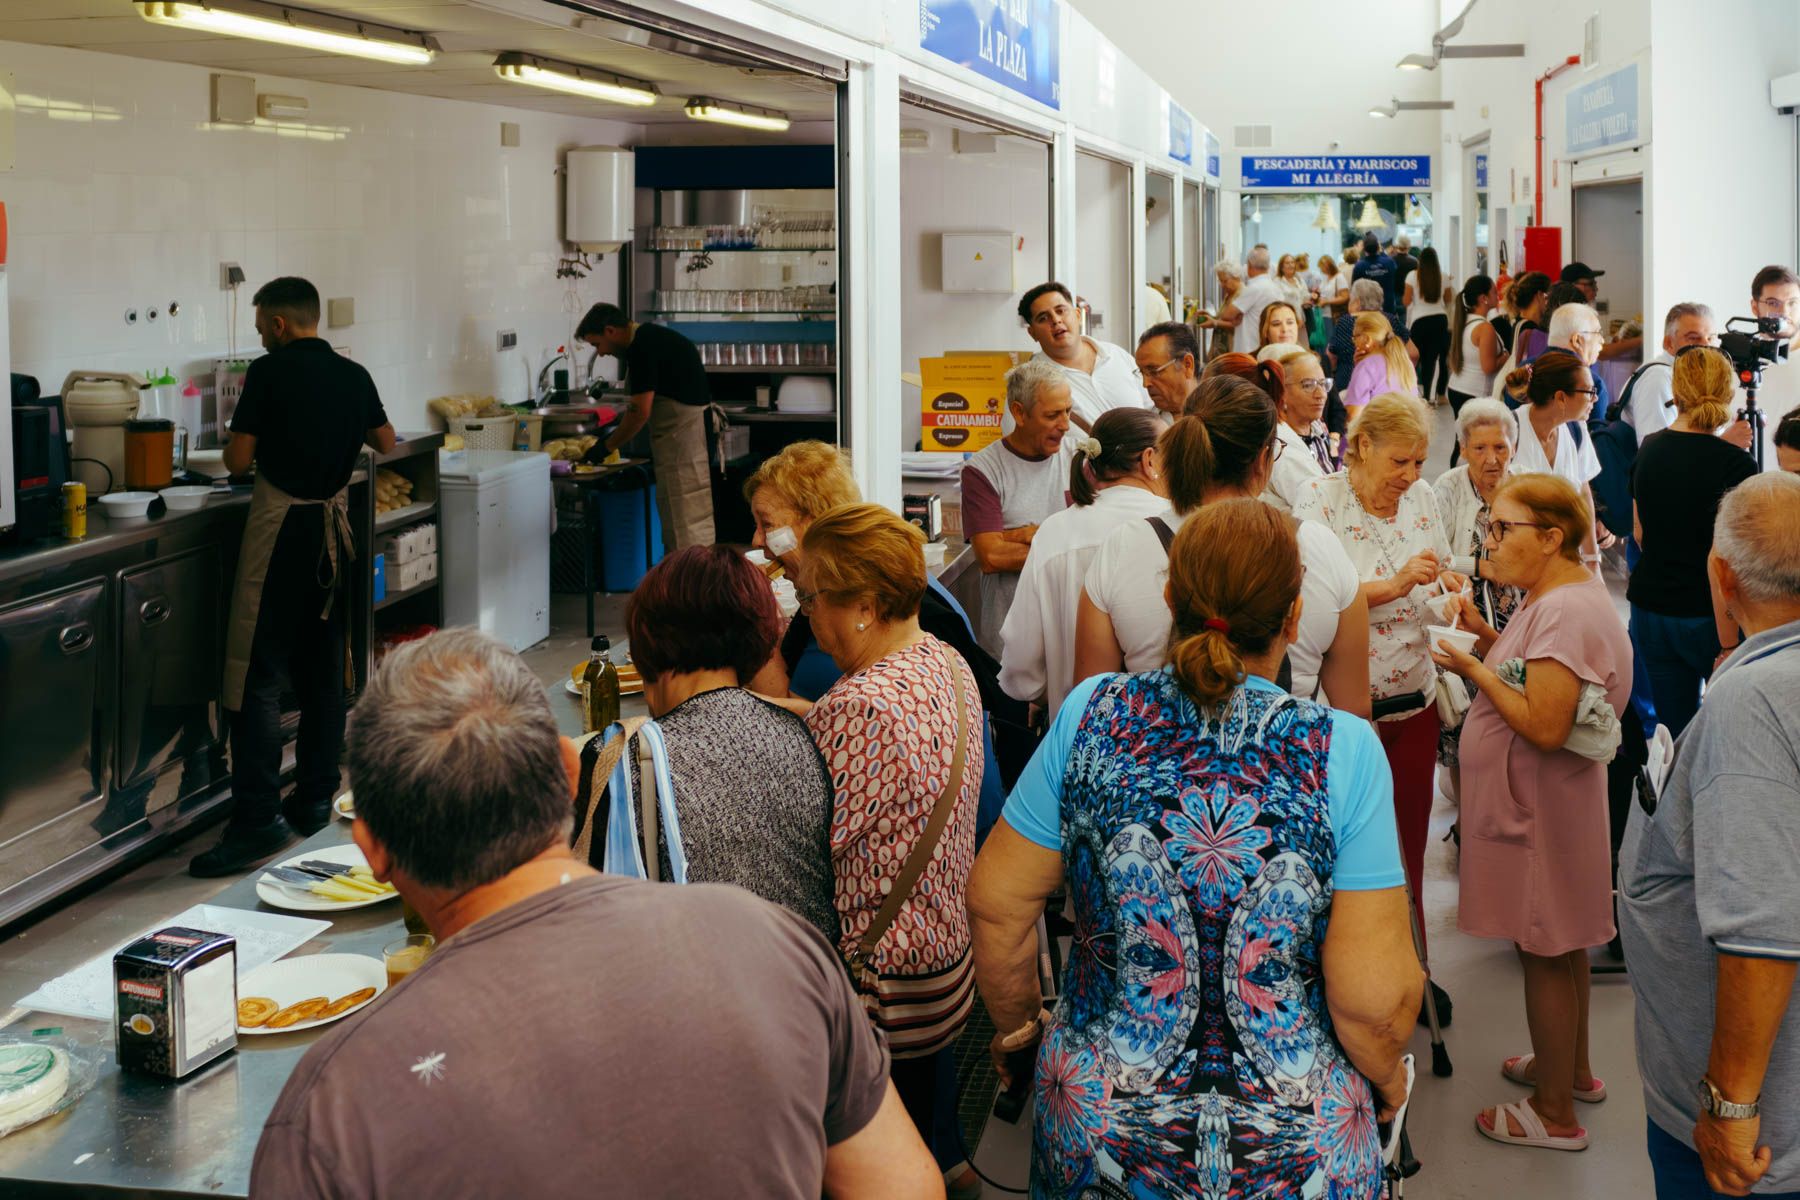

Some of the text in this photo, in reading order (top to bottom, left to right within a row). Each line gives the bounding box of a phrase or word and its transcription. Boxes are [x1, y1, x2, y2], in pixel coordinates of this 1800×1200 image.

[979, 19, 1027, 82] LA PLAZA
[1254, 157, 1418, 171] PESCADERÍA Y MARISCOS
[1292, 171, 1379, 185] MI ALEGRÍA
